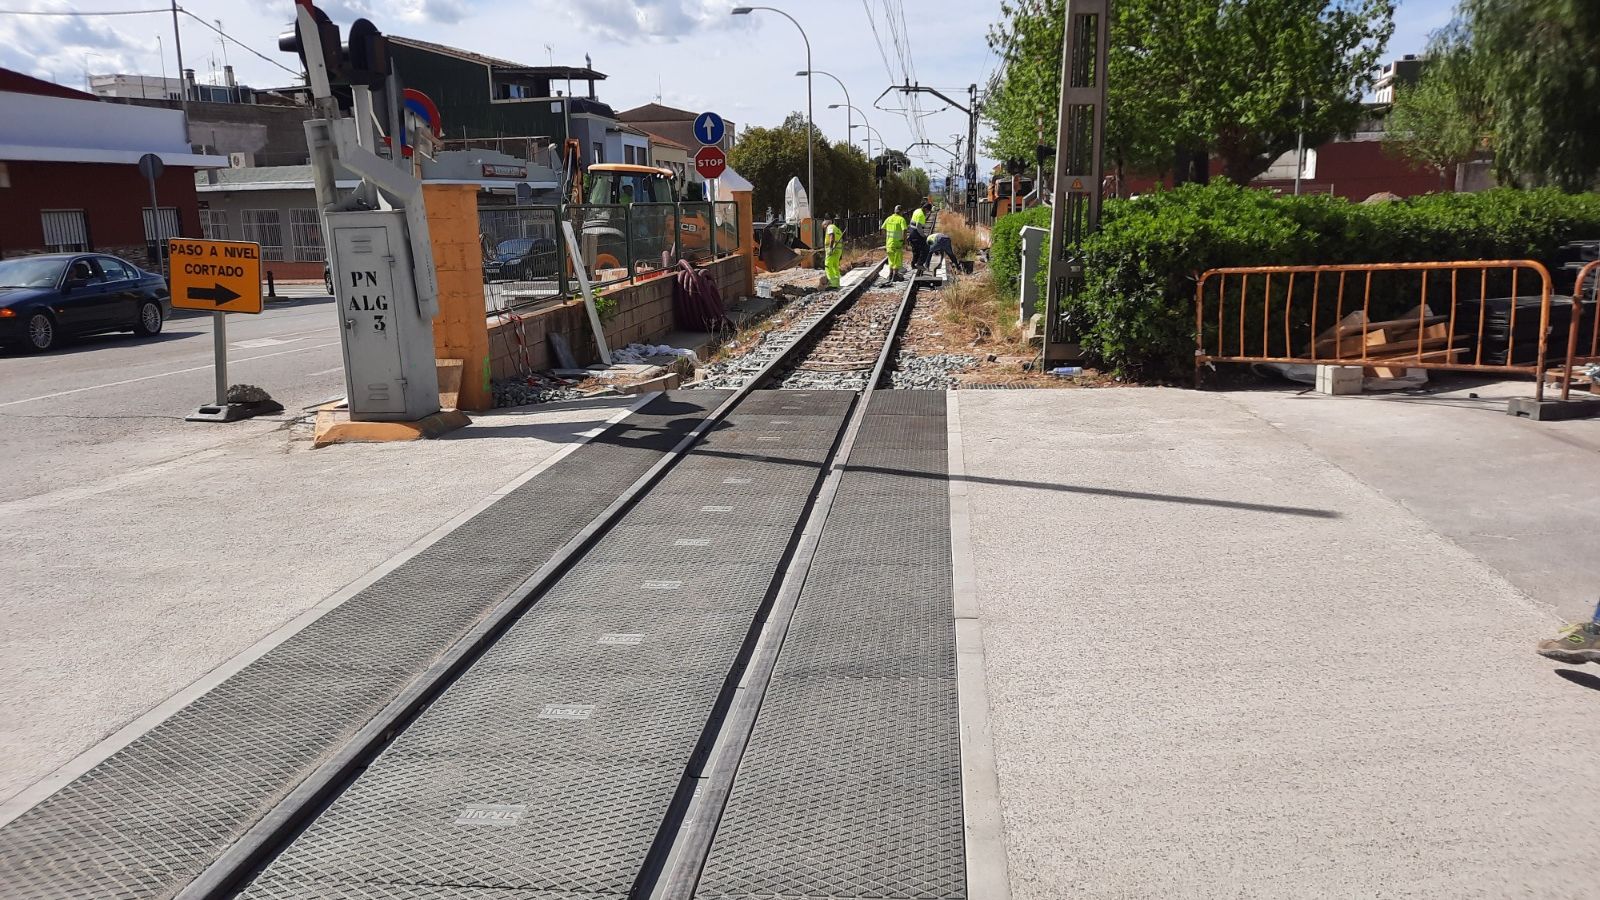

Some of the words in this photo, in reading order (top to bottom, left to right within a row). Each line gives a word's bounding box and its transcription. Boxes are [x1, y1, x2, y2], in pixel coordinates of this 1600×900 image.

[698, 158, 723, 167] STOP
[680, 223, 697, 232] CB
[170, 243, 203, 256] PASO
[209, 245, 218, 257] A
[224, 246, 258, 259] NIVEL
[184, 263, 244, 277] CORTADO
[350, 270, 377, 287] PN
[349, 295, 388, 311] ALG
[373, 315, 386, 331] 3
